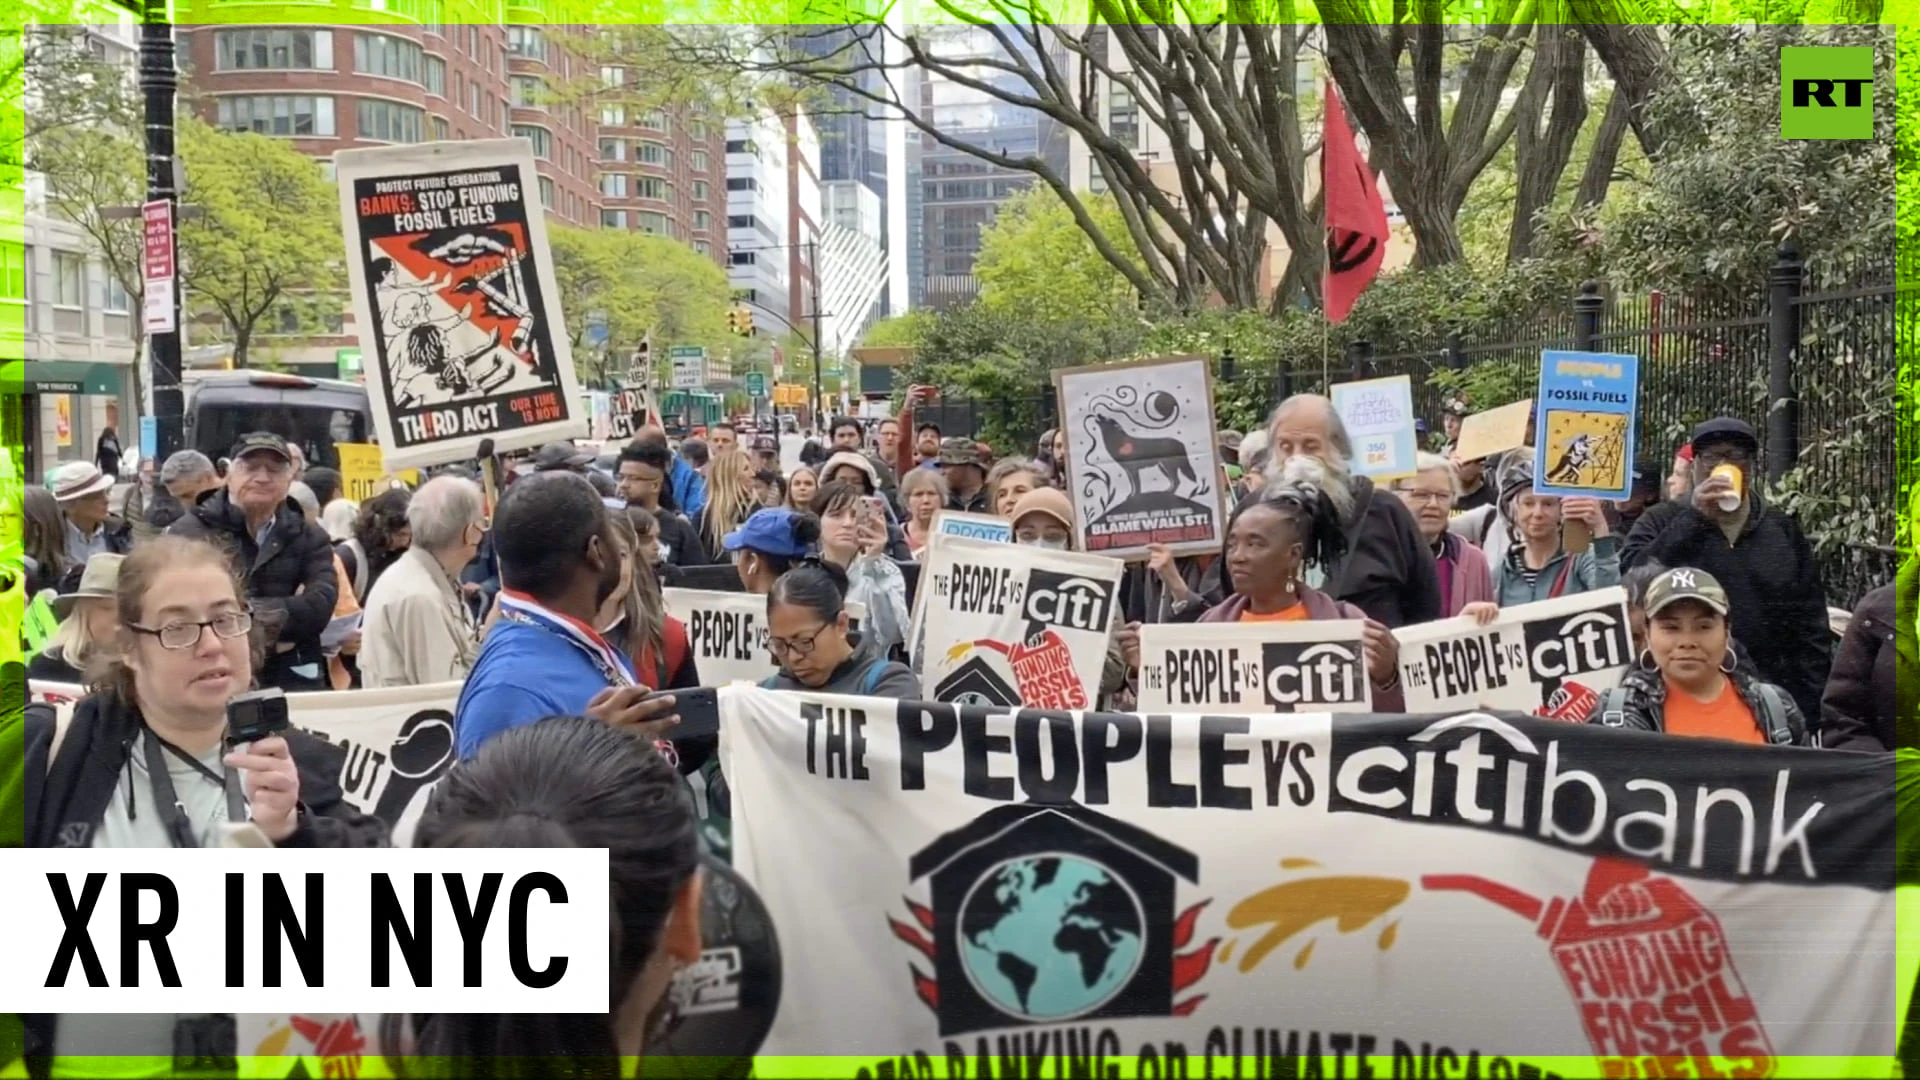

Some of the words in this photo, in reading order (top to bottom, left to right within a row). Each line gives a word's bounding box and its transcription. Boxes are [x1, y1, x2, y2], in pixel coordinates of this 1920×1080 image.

[360, 194, 416, 216] BANKS:
[418, 189, 455, 211] STOP
[459, 183, 519, 207] FUNDING
[376, 179, 413, 193] PROTECT
[414, 177, 447, 190] FUTURE
[448, 171, 502, 187] GENERATIONS
[394, 210, 447, 232] FOSSIL
[450, 205, 496, 227] FUELS
[510, 396, 532, 413] OUR
[533, 391, 557, 408] TIME
[522, 408, 534, 424] IS
[535, 405, 561, 422] NOW
[1548, 389, 1588, 401] FOSSIL
[1592, 391, 1628, 404] FUELS
[462, 402, 499, 433] ACT
[1091, 520, 1141, 535] BLAME
[1141, 517, 1184, 532] WALL
[1184, 513, 1208, 527] ST!
[934, 575, 948, 597] THE
[950, 563, 1011, 615] PEOPLE
[1010, 580, 1024, 604] VS
[1027, 577, 1106, 630] citi
[691, 609, 753, 661] PEOPLE
[1013, 645, 1070, 683] FUNDING
[1144, 665, 1162, 689] THE
[1165, 648, 1240, 704] PEOPLE
[1242, 664, 1259, 688] VS
[1267, 643, 1356, 703] citi
[1404, 660, 1427, 688] THE
[1425, 632, 1507, 699] PEOPLE
[1505, 643, 1523, 670] VS
[1531, 611, 1621, 678] citi
[1020, 667, 1081, 704] FOSSIL
[800, 702, 871, 781] THE
[897, 699, 1254, 812] PEOPLE
[1262, 739, 1317, 808] VS
[1336, 712, 1825, 879] citibank
[1557, 917, 1724, 1001] FUNDING
[1581, 973, 1758, 1058] FOSSIL
